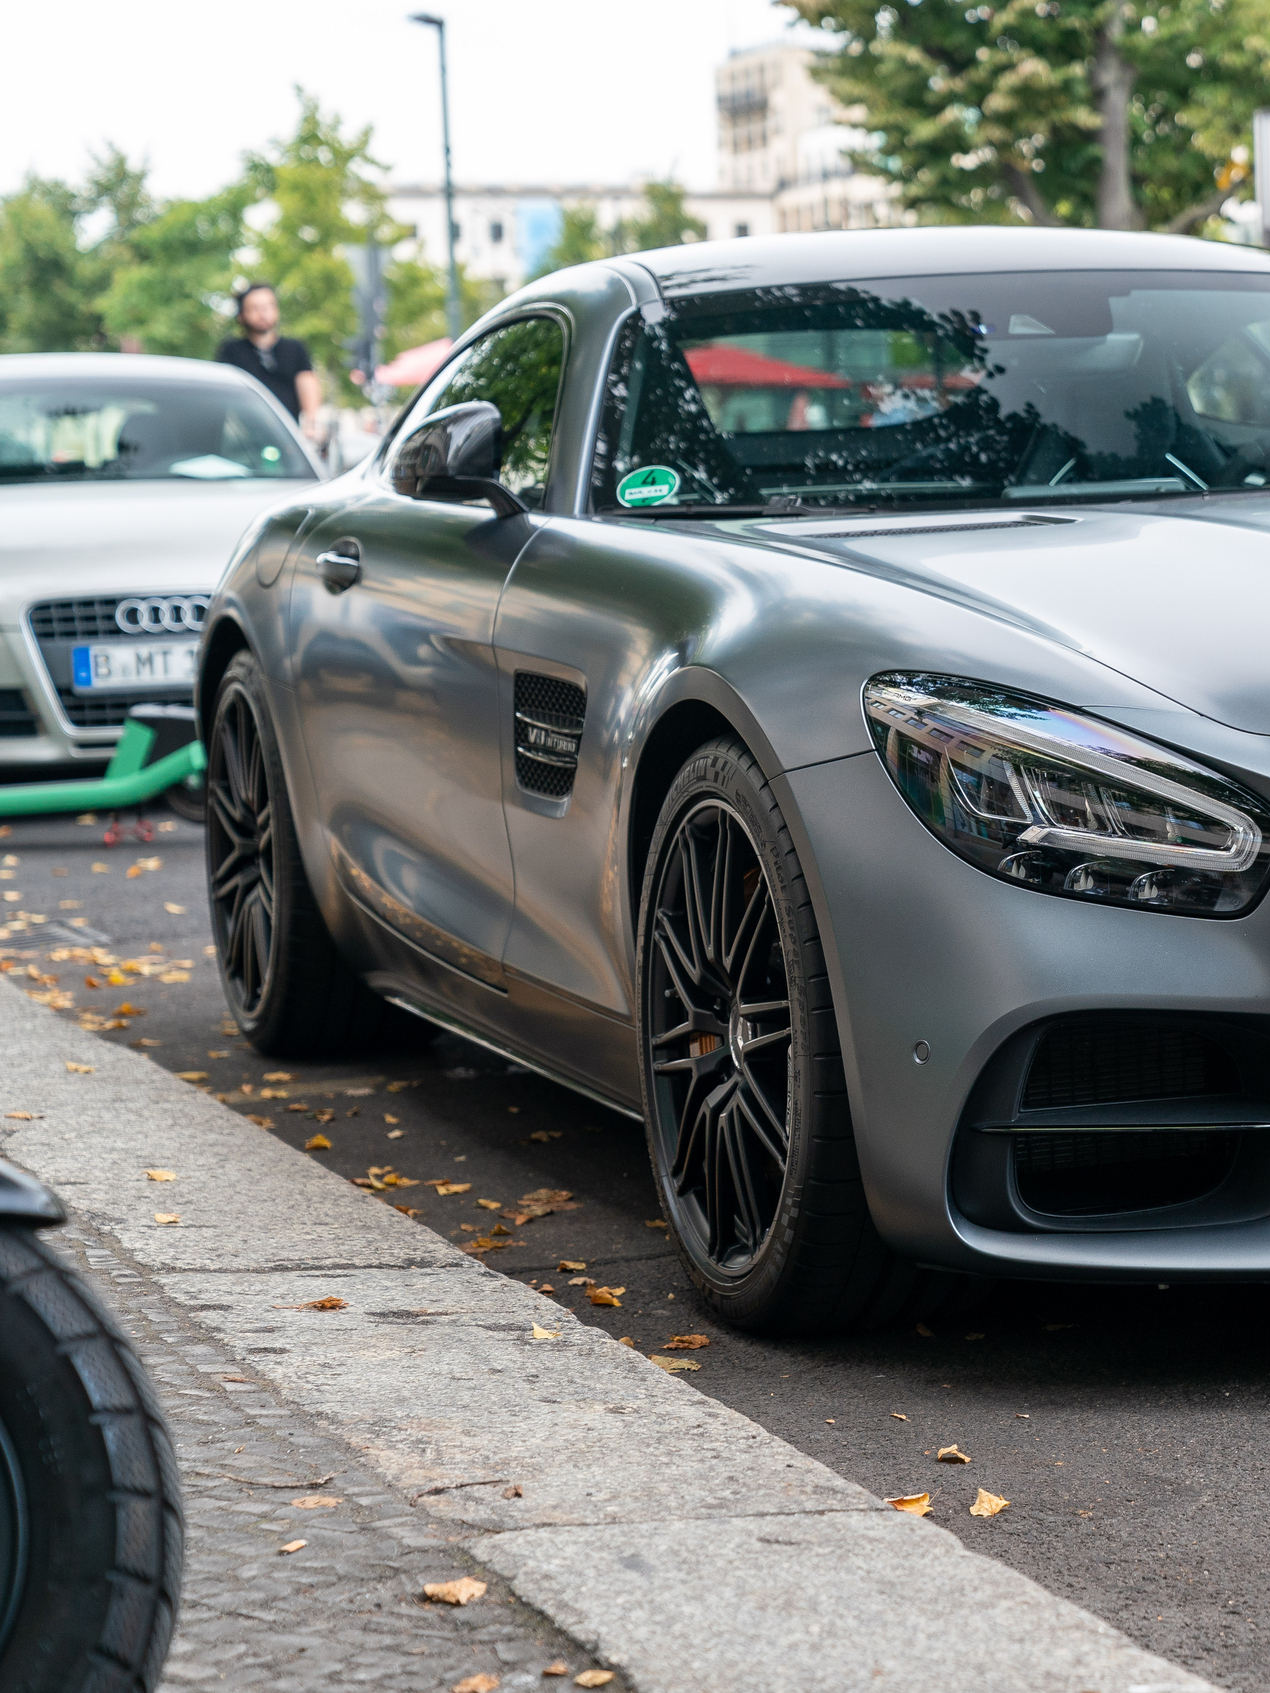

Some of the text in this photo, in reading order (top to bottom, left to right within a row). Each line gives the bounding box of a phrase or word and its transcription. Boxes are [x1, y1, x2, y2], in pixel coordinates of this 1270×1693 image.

[641, 469, 657, 486] 4
[94, 653, 112, 678] B
[135, 650, 171, 677] MT
